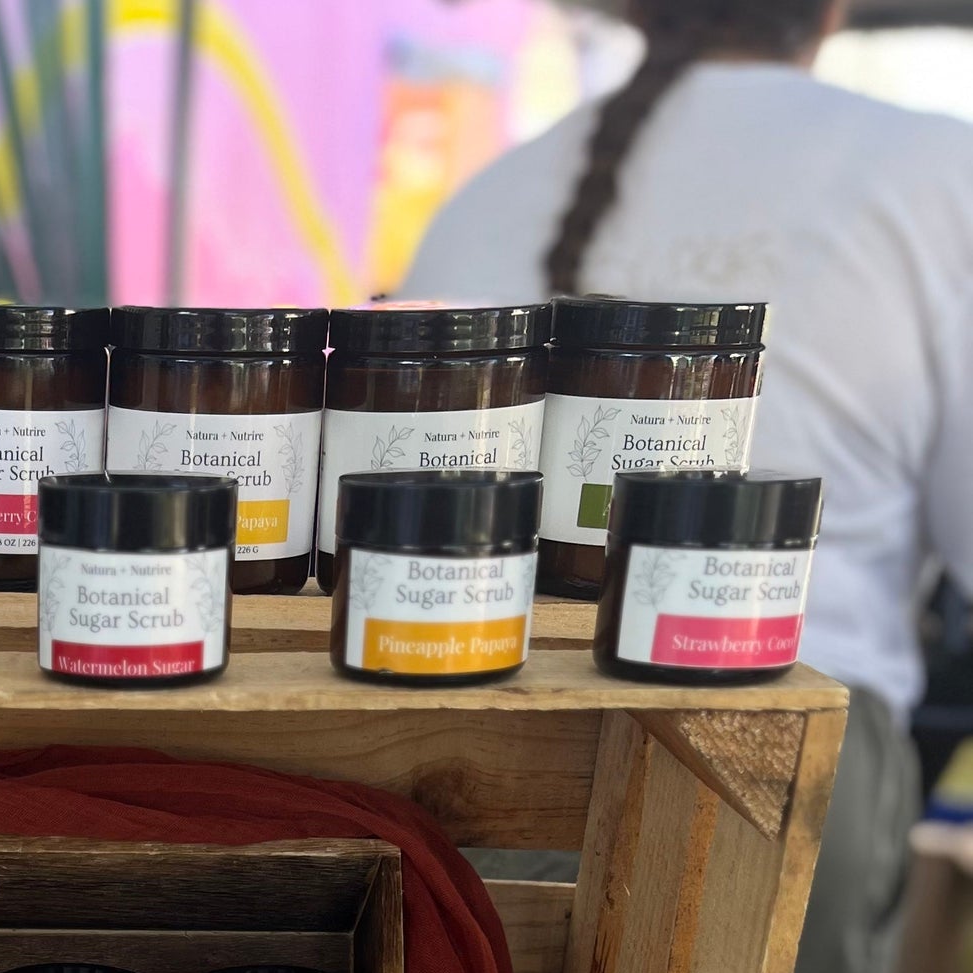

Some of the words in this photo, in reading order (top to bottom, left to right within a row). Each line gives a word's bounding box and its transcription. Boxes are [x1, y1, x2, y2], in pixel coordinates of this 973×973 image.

[630, 414, 665, 425] Natura
[677, 415, 712, 425] Nutrire
[12, 427, 46, 438] Nutrire
[186, 430, 219, 441] Natura
[230, 430, 264, 441] Nutrire
[424, 432, 457, 442] Natura
[468, 429, 500, 440] Nutrire
[623, 434, 707, 451] Botanical
[181, 449, 261, 467] Botanical
[419, 447, 497, 467] Botanical
[10, 465, 55, 482] Scrub
[4, 539, 17, 547] OZ
[23, 539, 36, 547] 226
[237, 546, 251, 554] 226
[252, 546, 259, 554] G
[80, 563, 117, 577] Natura
[130, 562, 172, 577] Nutrire
[408, 560, 504, 581] Botanical
[703, 556, 797, 577] Botanical
[78, 586, 170, 606] Botanical
[395, 584, 457, 610] Sugar
[463, 581, 514, 604] Scrub
[687, 580, 751, 606] Sugar
[757, 580, 801, 601] Scrub
[69, 608, 122, 633] Sugar
[128, 609, 184, 629] Scrub
[379, 635, 465, 658] Pineapple
[470, 635, 517, 657] Papaya
[672, 633, 764, 655] Strawberry
[58, 655, 148, 676] Watermelon
[151, 659, 195, 675] Sugar
